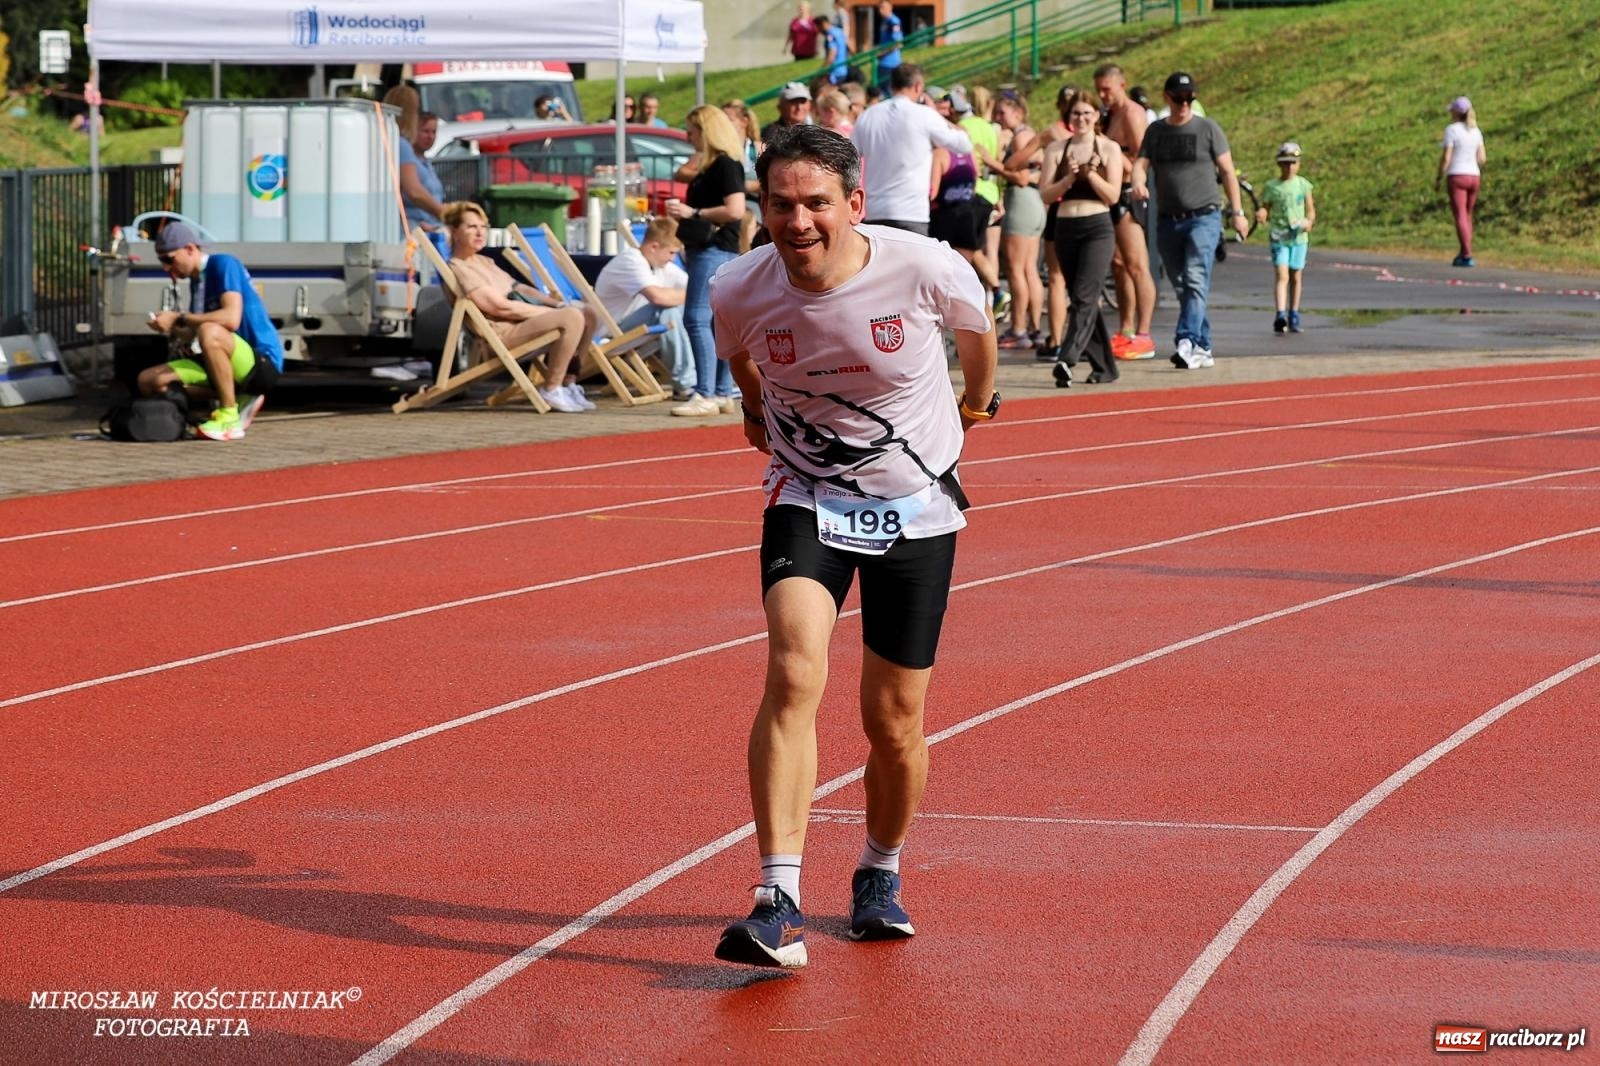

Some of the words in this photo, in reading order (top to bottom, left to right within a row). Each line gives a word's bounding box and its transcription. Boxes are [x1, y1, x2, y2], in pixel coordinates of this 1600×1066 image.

[328, 15, 426, 32] Wodociągi
[329, 32, 426, 46] Raciborskie
[828, 490, 847, 498] maja
[844, 509, 902, 535] 198
